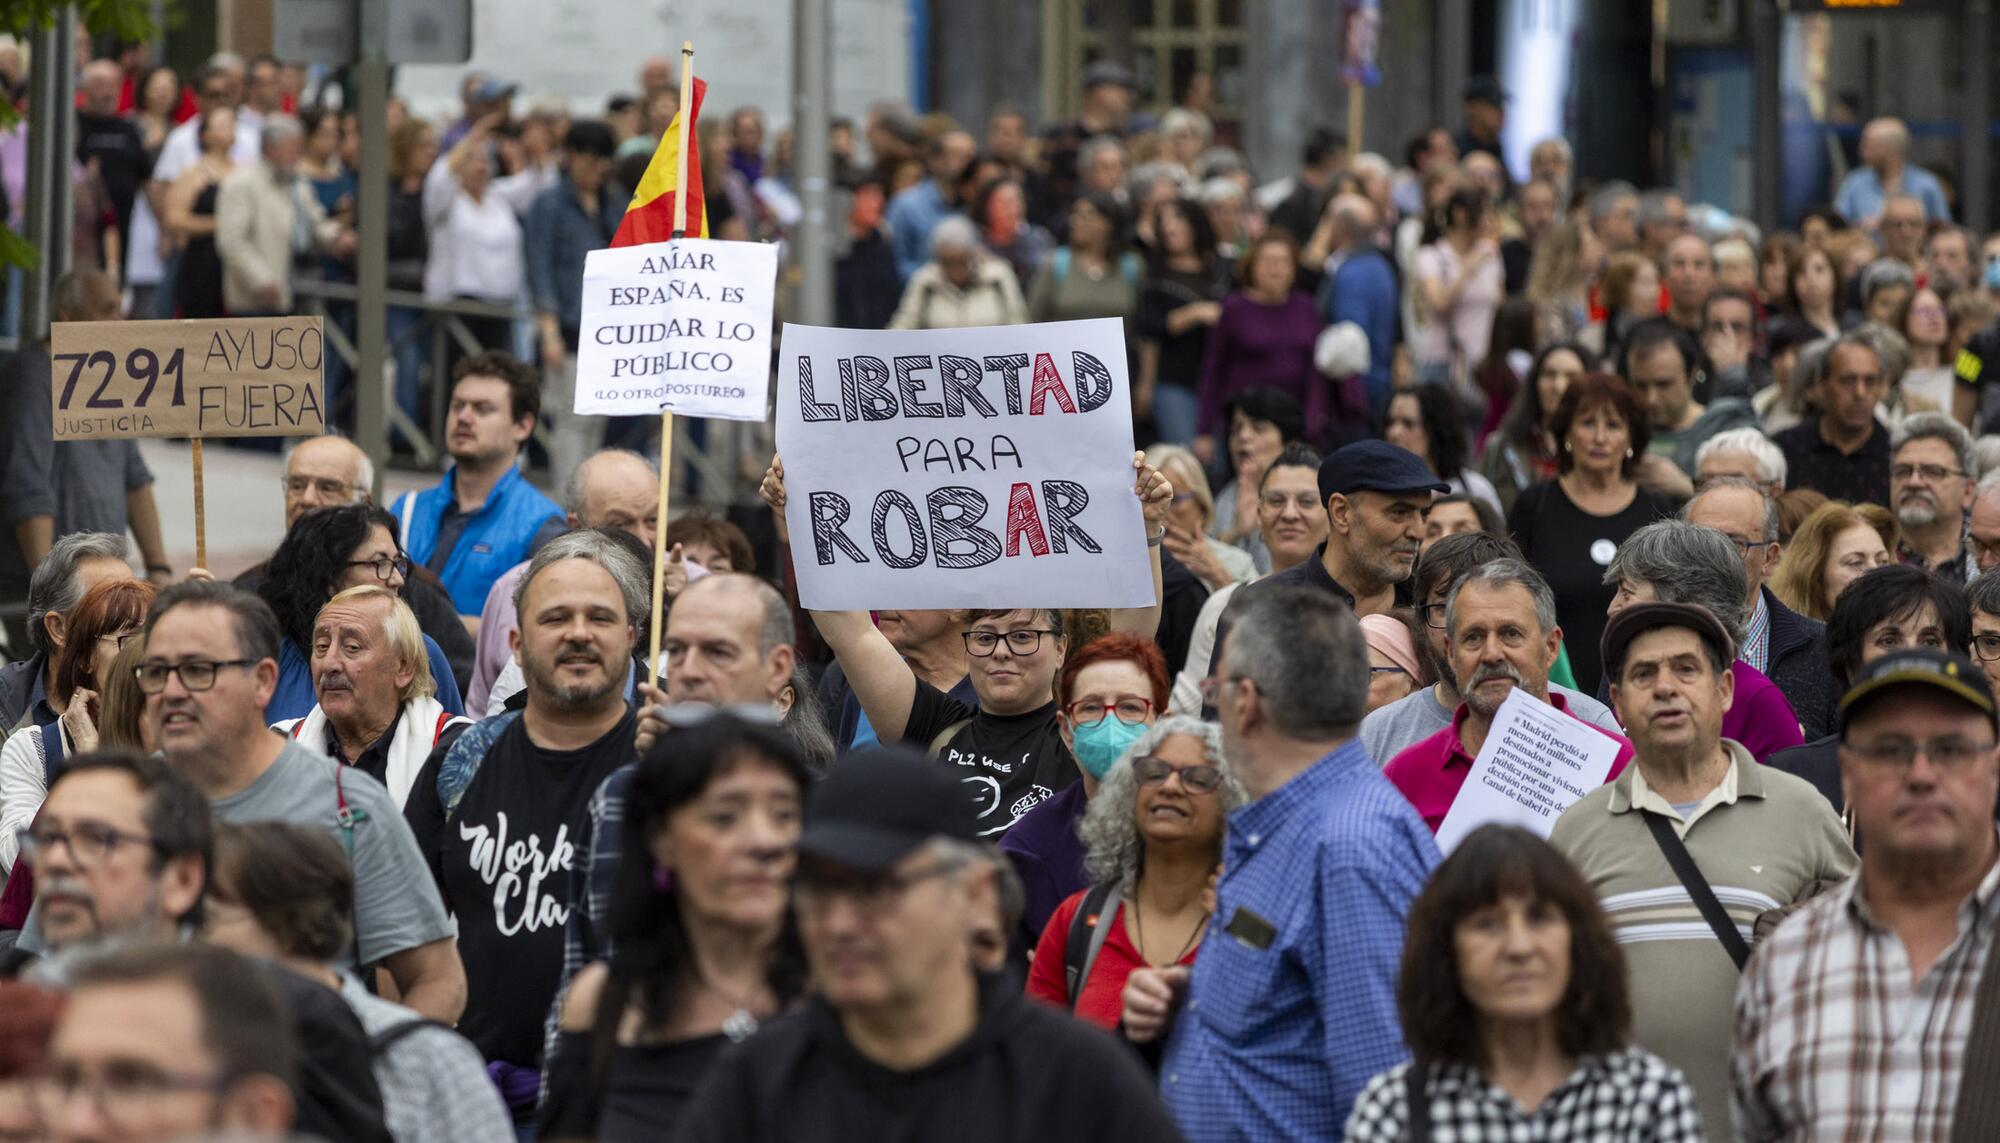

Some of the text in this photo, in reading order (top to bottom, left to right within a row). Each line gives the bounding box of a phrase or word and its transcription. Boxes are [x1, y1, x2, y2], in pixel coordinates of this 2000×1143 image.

[640, 252, 717, 274] AMAR
[721, 287, 745, 303] ES
[203, 326, 322, 373] AYUSO
[595, 318, 755, 345] CUIDAR LO
[53, 347, 186, 410] 7291
[611, 351, 733, 378] PÚBLICO
[199, 382, 323, 431] FUERA
[622, 387, 664, 400] OTRO
[665, 383, 746, 400] POSTUREO)
[798, 350, 1112, 422] LIBERTAD
[54, 413, 155, 436] JUSTICIA
[896, 435, 1022, 474] PARA
[808, 479, 1103, 569] ROBAR
[1502, 735, 1553, 768] destinados a
[1507, 726, 1582, 771] menos 40 millones
[1520, 719, 1552, 742] Madrid
[1550, 737, 1580, 757] perdió
[1578, 752, 1590, 763] al
[1487, 765, 1521, 788] decisión
[1519, 784, 1554, 807] errónea
[1491, 756, 1556, 796] pública por una
[1496, 746, 1586, 799] promocionar vivienda
[1482, 775, 1551, 818] Canal de Isabel II
[493, 871, 570, 937] Cla
